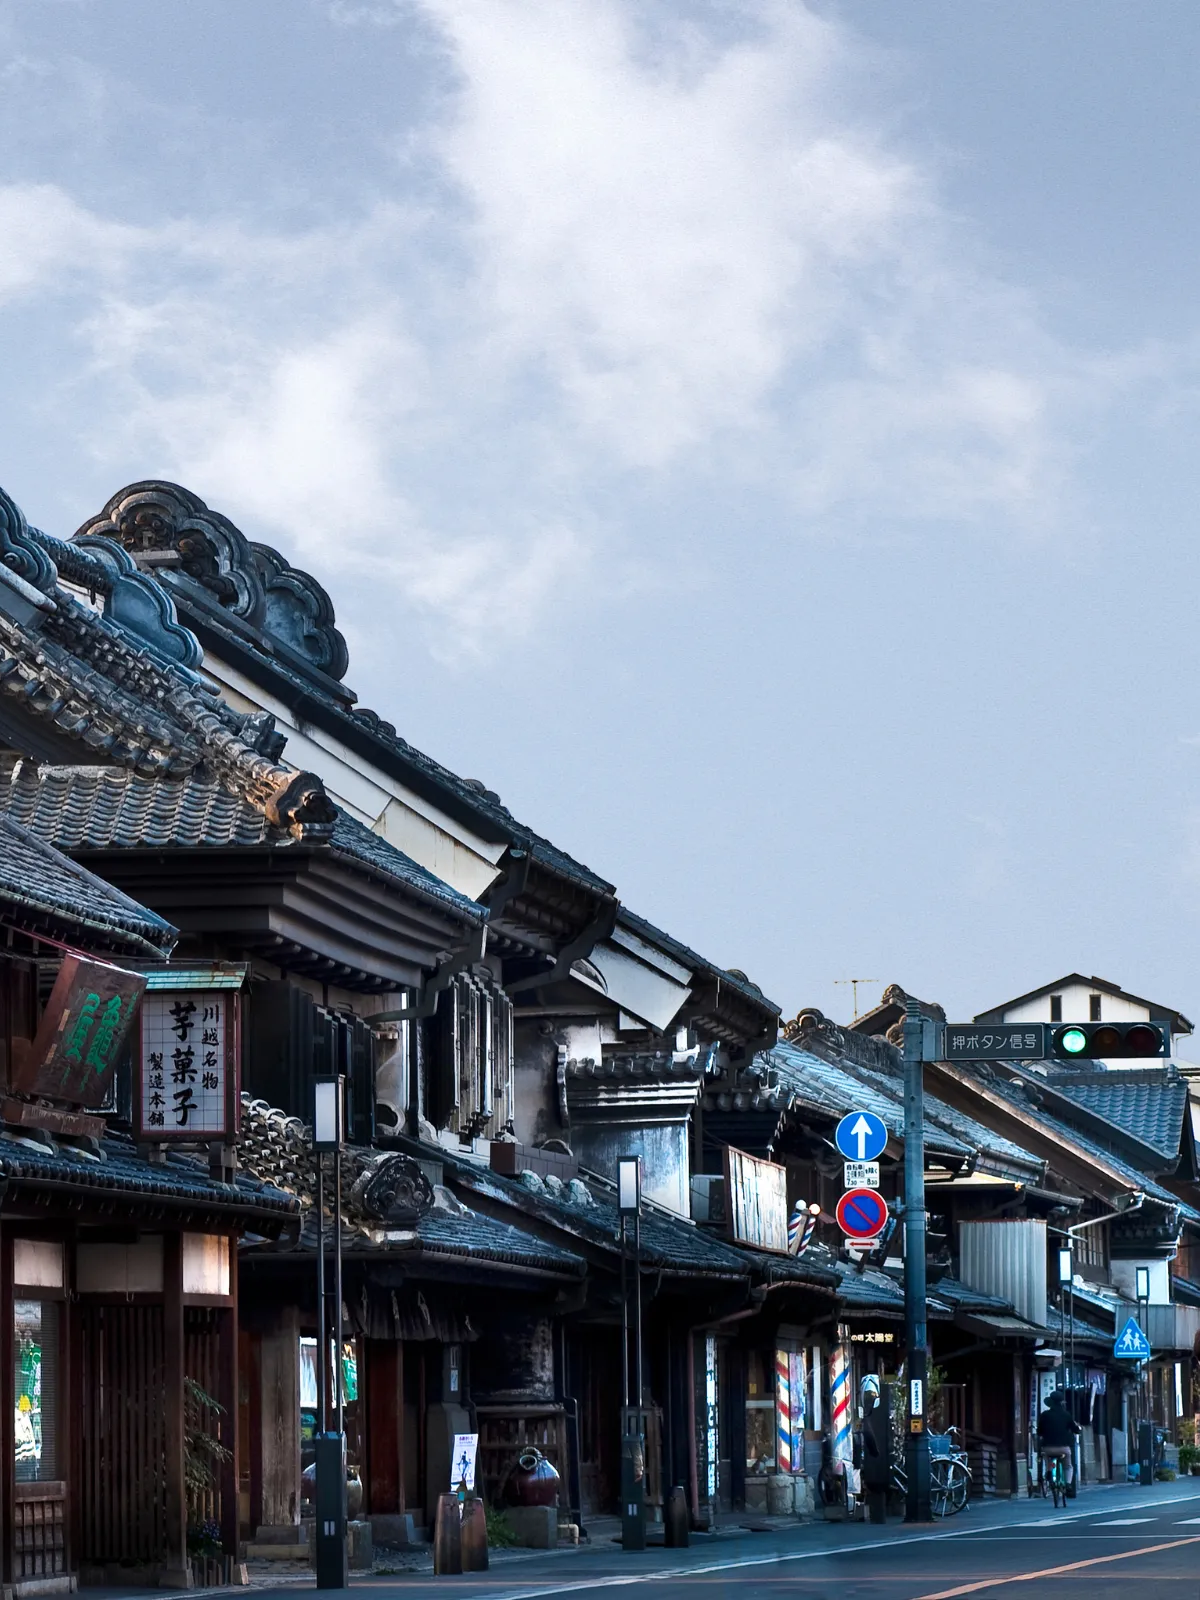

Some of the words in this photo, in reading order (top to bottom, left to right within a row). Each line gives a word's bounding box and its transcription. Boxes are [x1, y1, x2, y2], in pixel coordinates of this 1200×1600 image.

[169, 1001, 197, 1126] 芋菓子
[202, 1005, 219, 1090] 川越名物
[952, 1033, 1037, 1050] 押ボタン信号
[147, 1052, 165, 1126] 製造本舗
